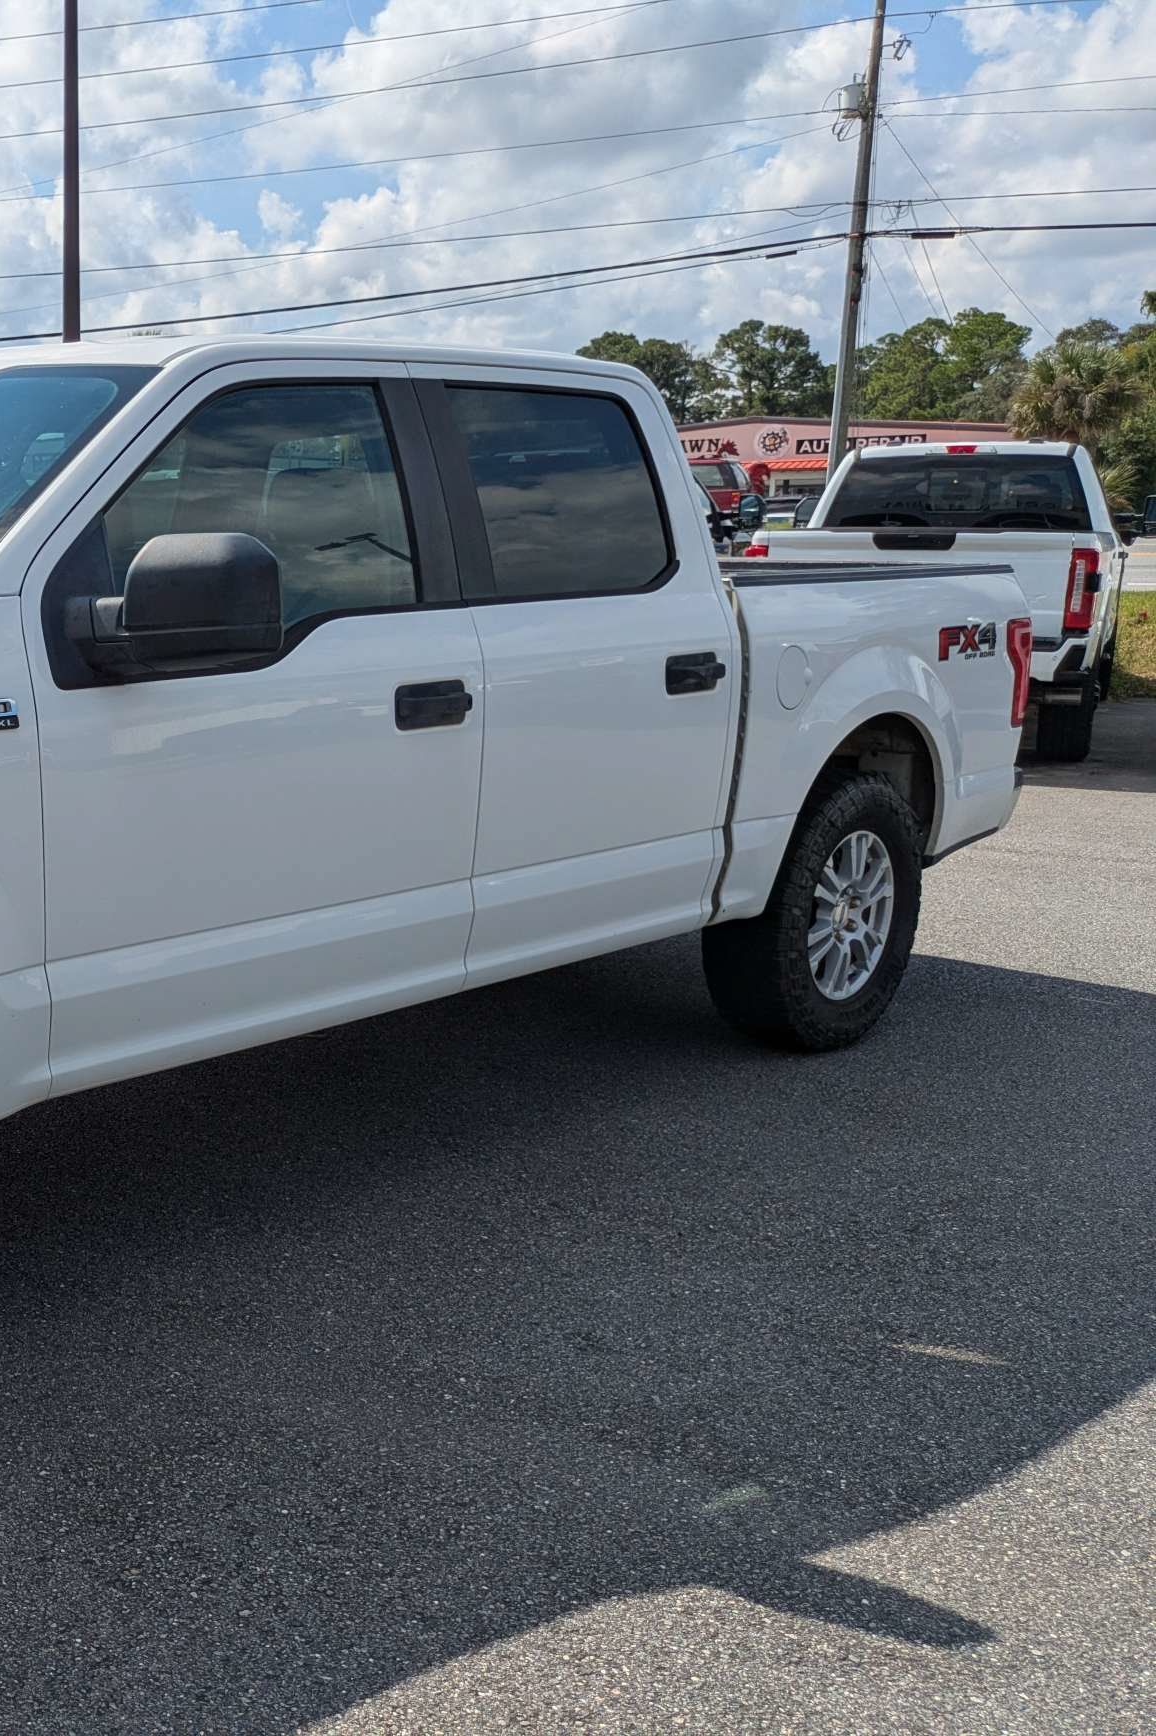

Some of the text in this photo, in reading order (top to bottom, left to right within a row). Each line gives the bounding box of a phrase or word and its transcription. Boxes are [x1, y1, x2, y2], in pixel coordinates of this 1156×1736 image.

[799, 435, 924, 454] AU REPIR
[938, 622, 996, 662] FX4
